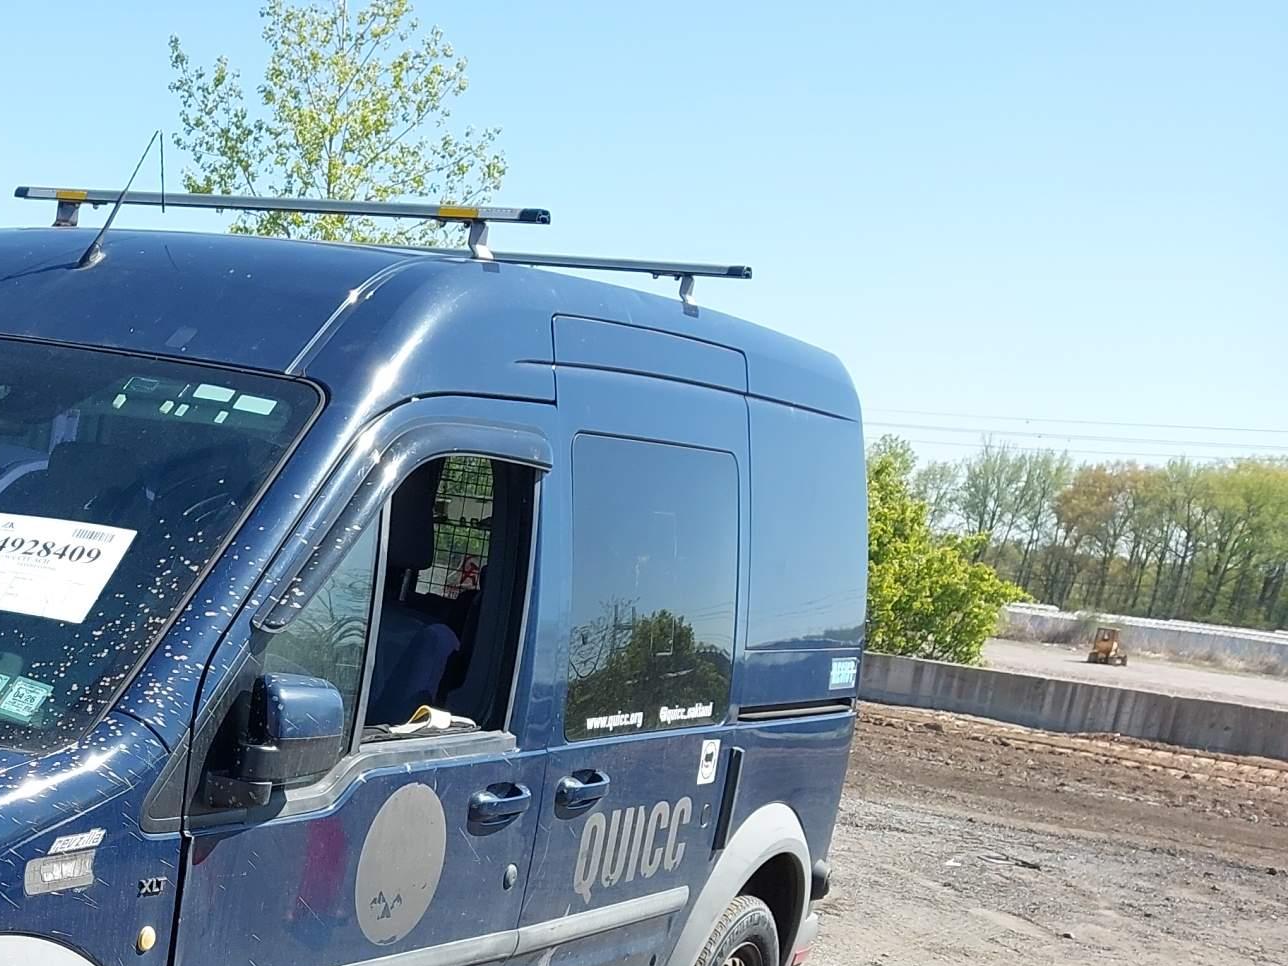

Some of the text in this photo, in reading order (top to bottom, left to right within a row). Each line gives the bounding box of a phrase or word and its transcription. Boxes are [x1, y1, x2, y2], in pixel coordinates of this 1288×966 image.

[586, 710, 644, 732] www.quicc.org
[573, 796, 693, 904] QUICC
[139, 876, 168, 894] XLT
